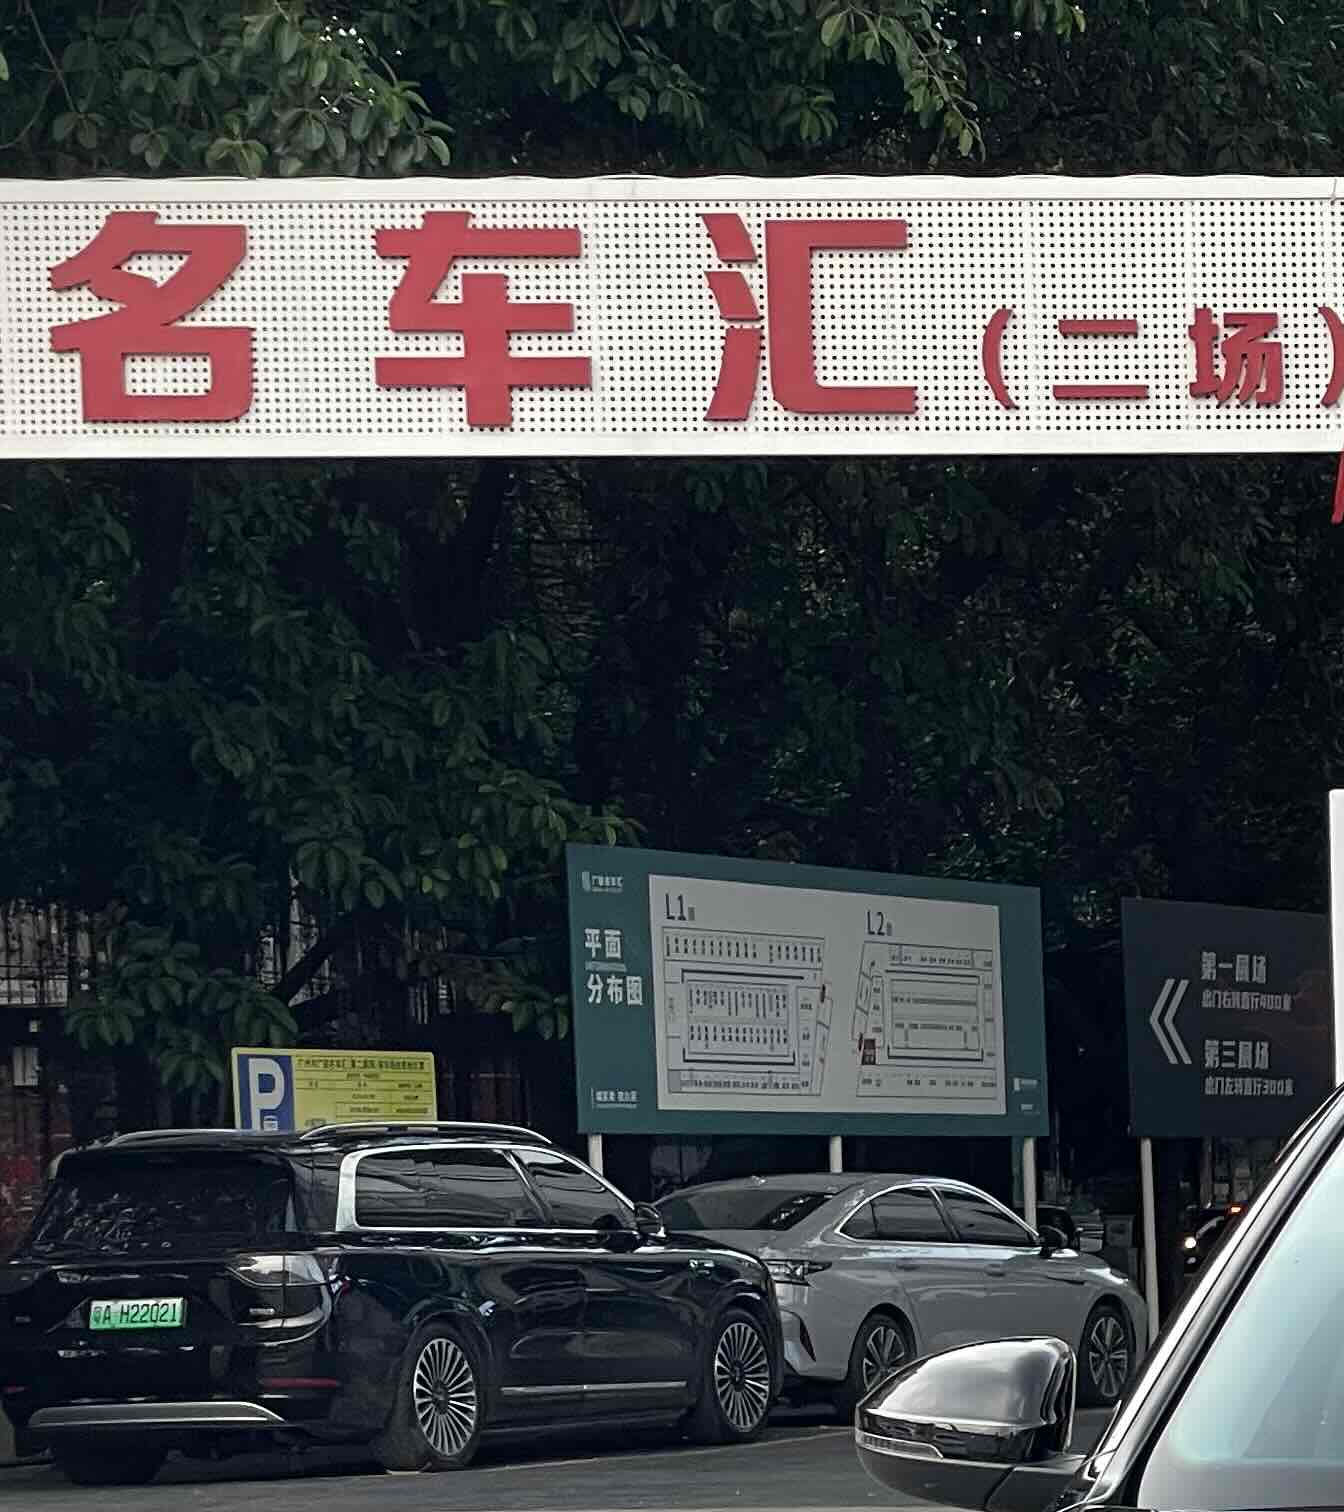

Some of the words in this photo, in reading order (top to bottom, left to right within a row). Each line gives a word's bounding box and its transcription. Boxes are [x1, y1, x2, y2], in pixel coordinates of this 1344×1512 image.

[585, 928, 622, 958] 平面
[586, 973, 643, 1006] 分布图
[248, 1058, 285, 1130] P
